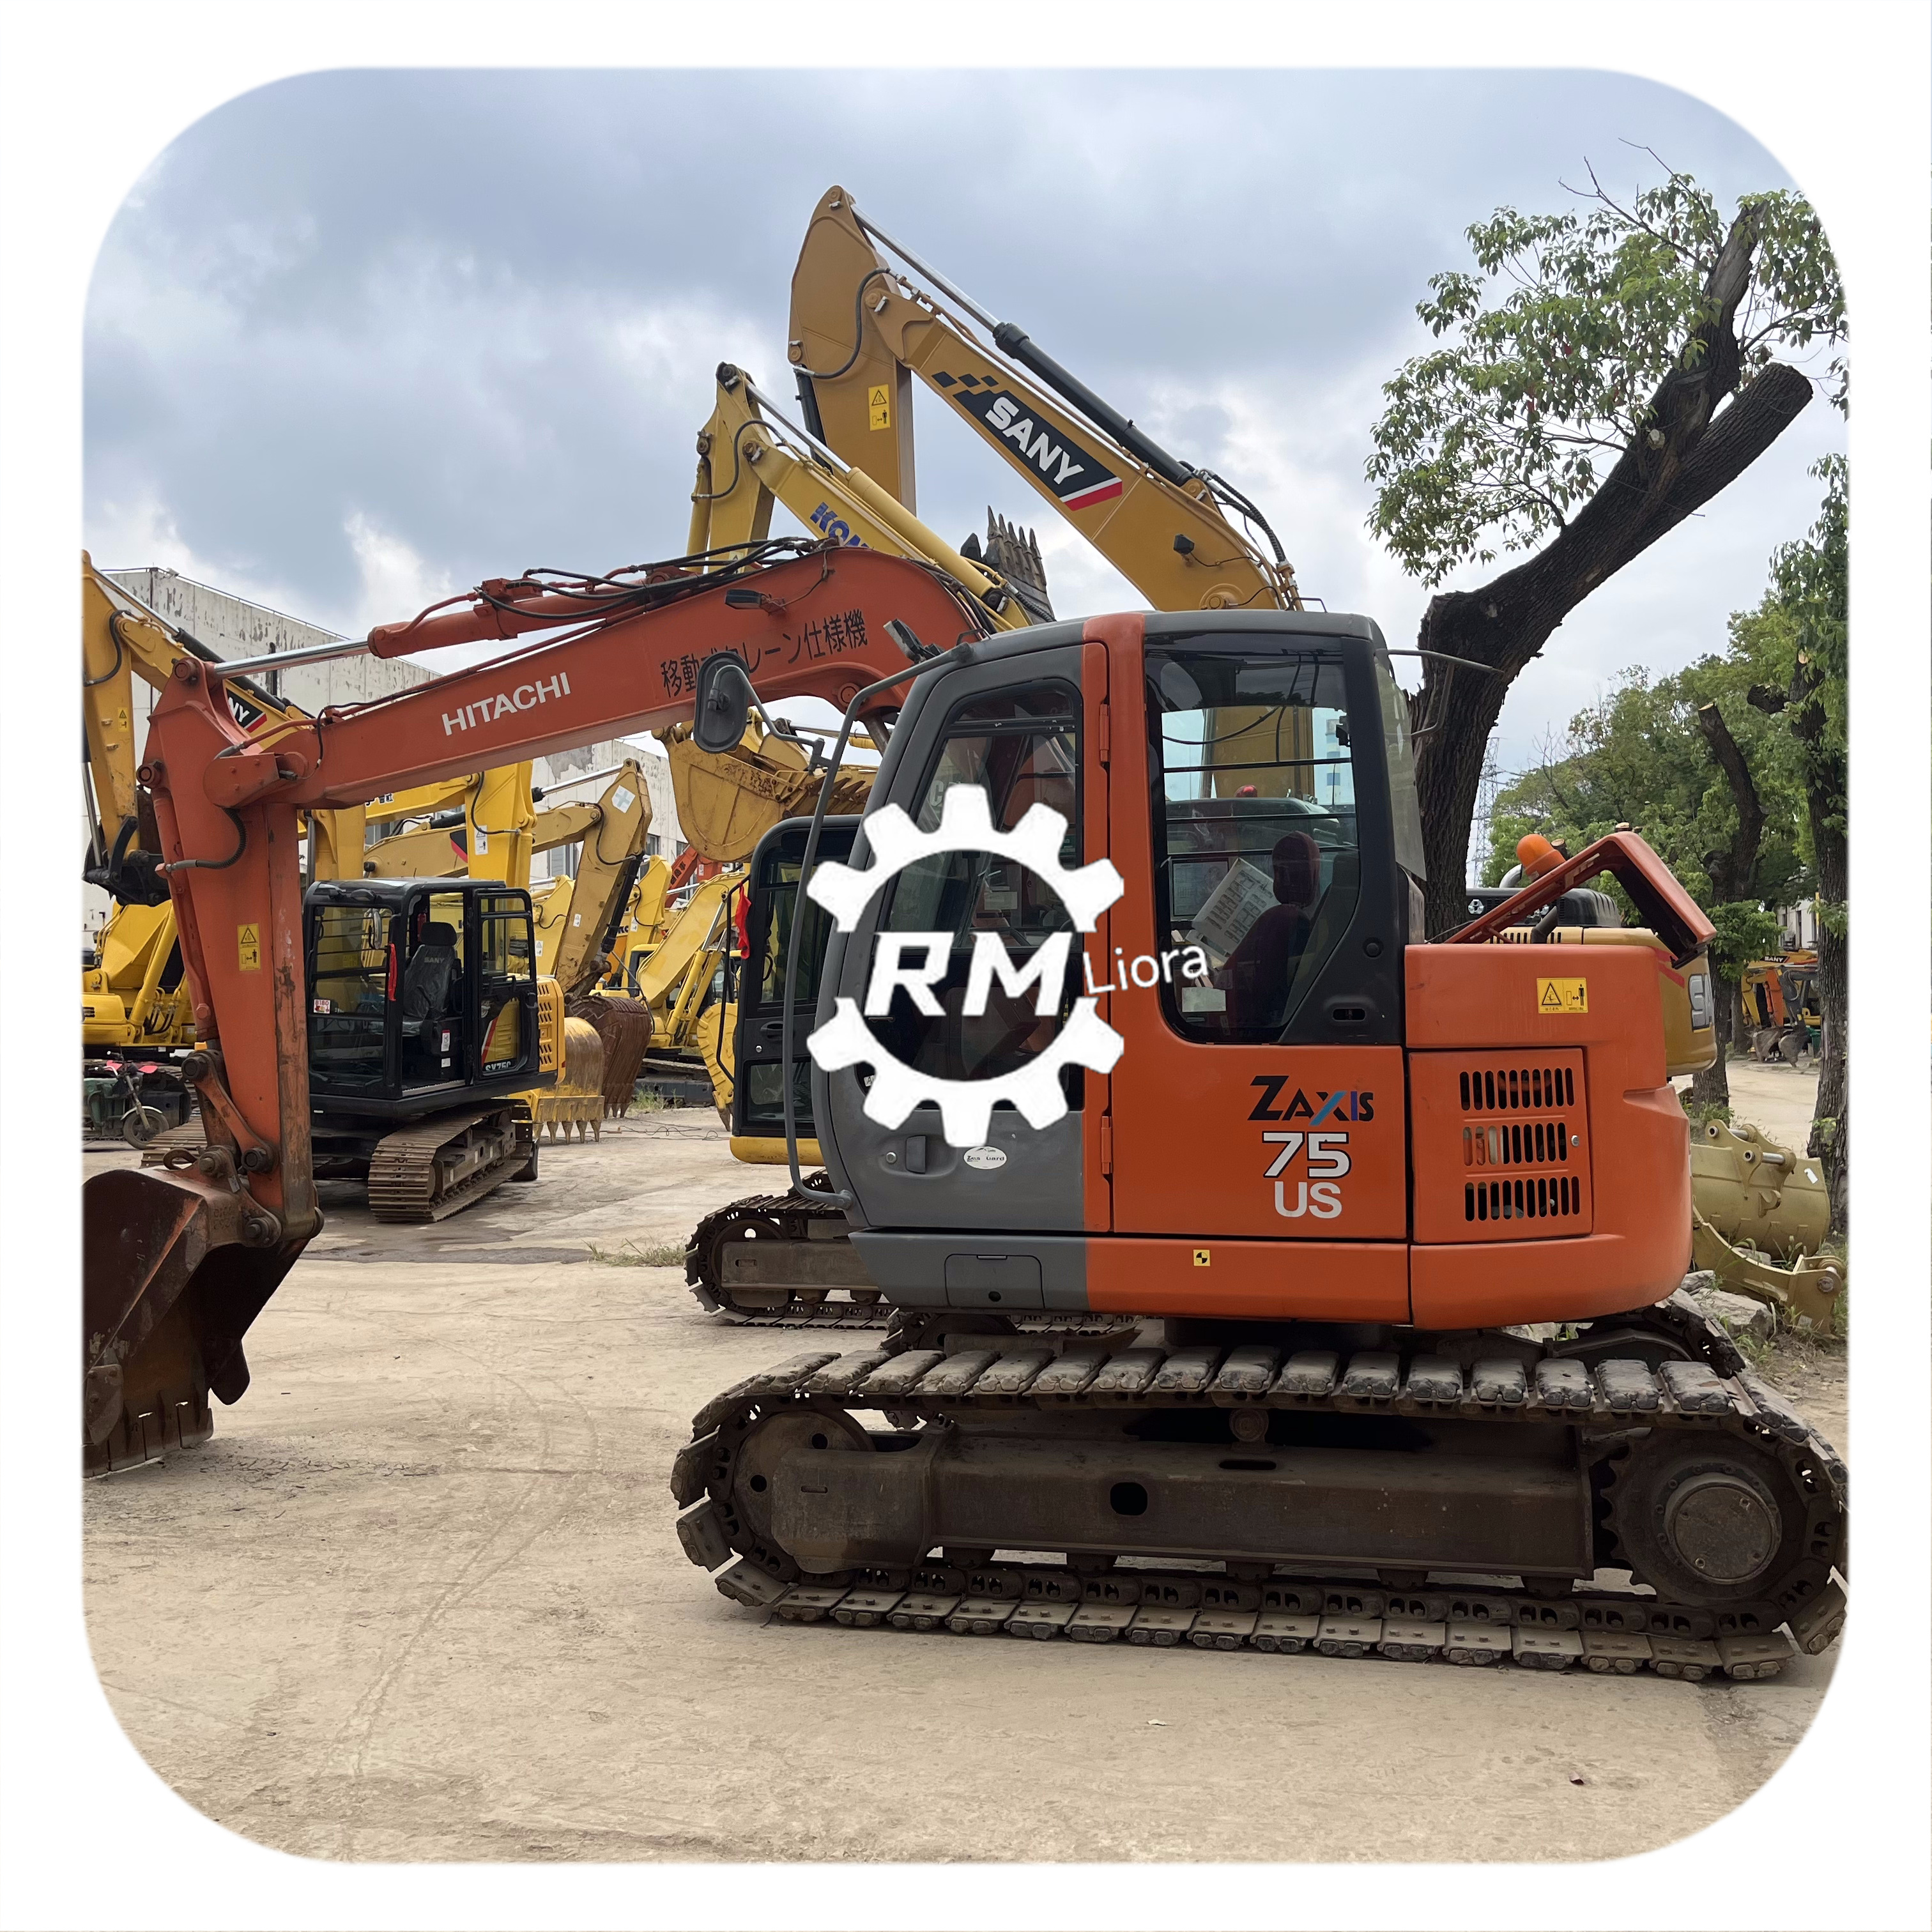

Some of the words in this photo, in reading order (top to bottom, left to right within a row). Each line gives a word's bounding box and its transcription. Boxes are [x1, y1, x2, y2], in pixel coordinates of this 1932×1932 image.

[985, 396, 1085, 485] SANY
[660, 608, 868, 698] 移動レーン仕様機
[227, 696, 250, 723] NY
[441, 671, 571, 737] HITACHI
[1246, 1075, 1374, 1126] ZAXIS
[1261, 1130, 1352, 1179] 75
[1274, 1181, 1342, 1219] US
